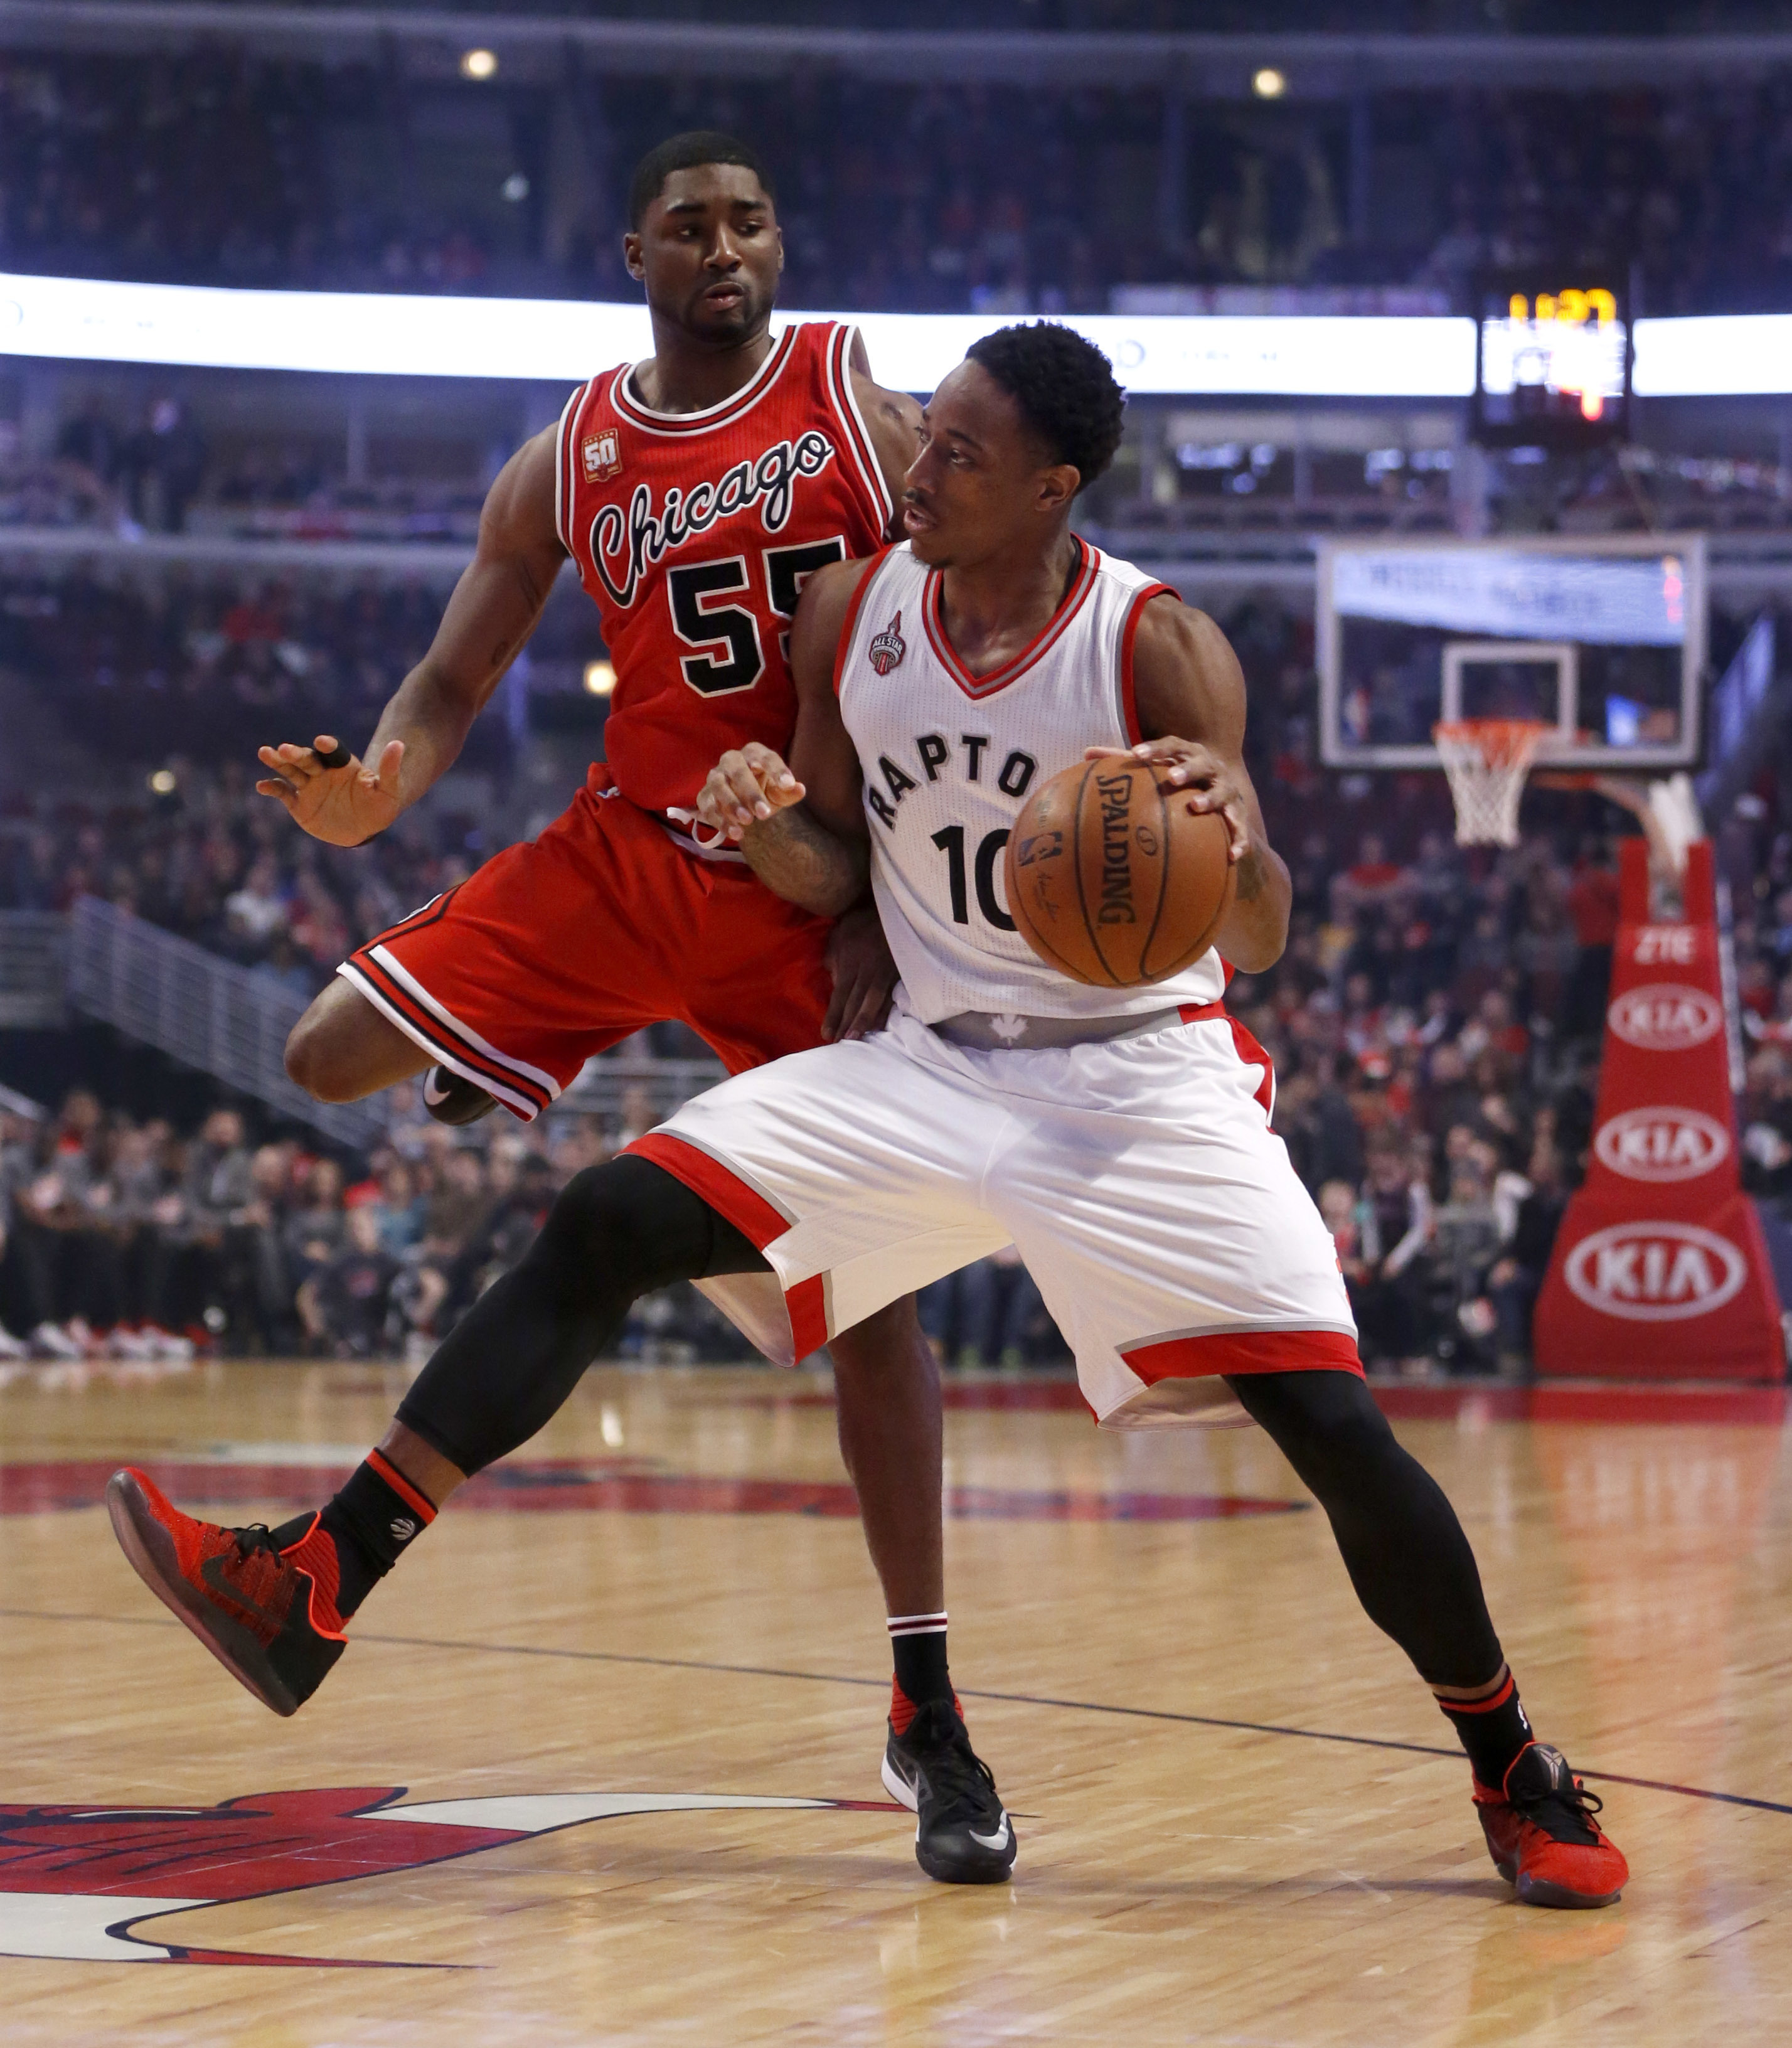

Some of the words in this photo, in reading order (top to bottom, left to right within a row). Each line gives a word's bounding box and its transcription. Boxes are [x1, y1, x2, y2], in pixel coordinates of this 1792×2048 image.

[584, 437, 617, 472] 50
[590, 430, 835, 609] Chicago
[1097, 774, 1136, 925] SPALDING
[931, 825, 1018, 931] 10
[1634, 927, 1695, 964] ZTE
[1629, 999, 1698, 1032] KIA
[1615, 1126, 1705, 1163] KIA
[1595, 1245, 1716, 1299] KIA
